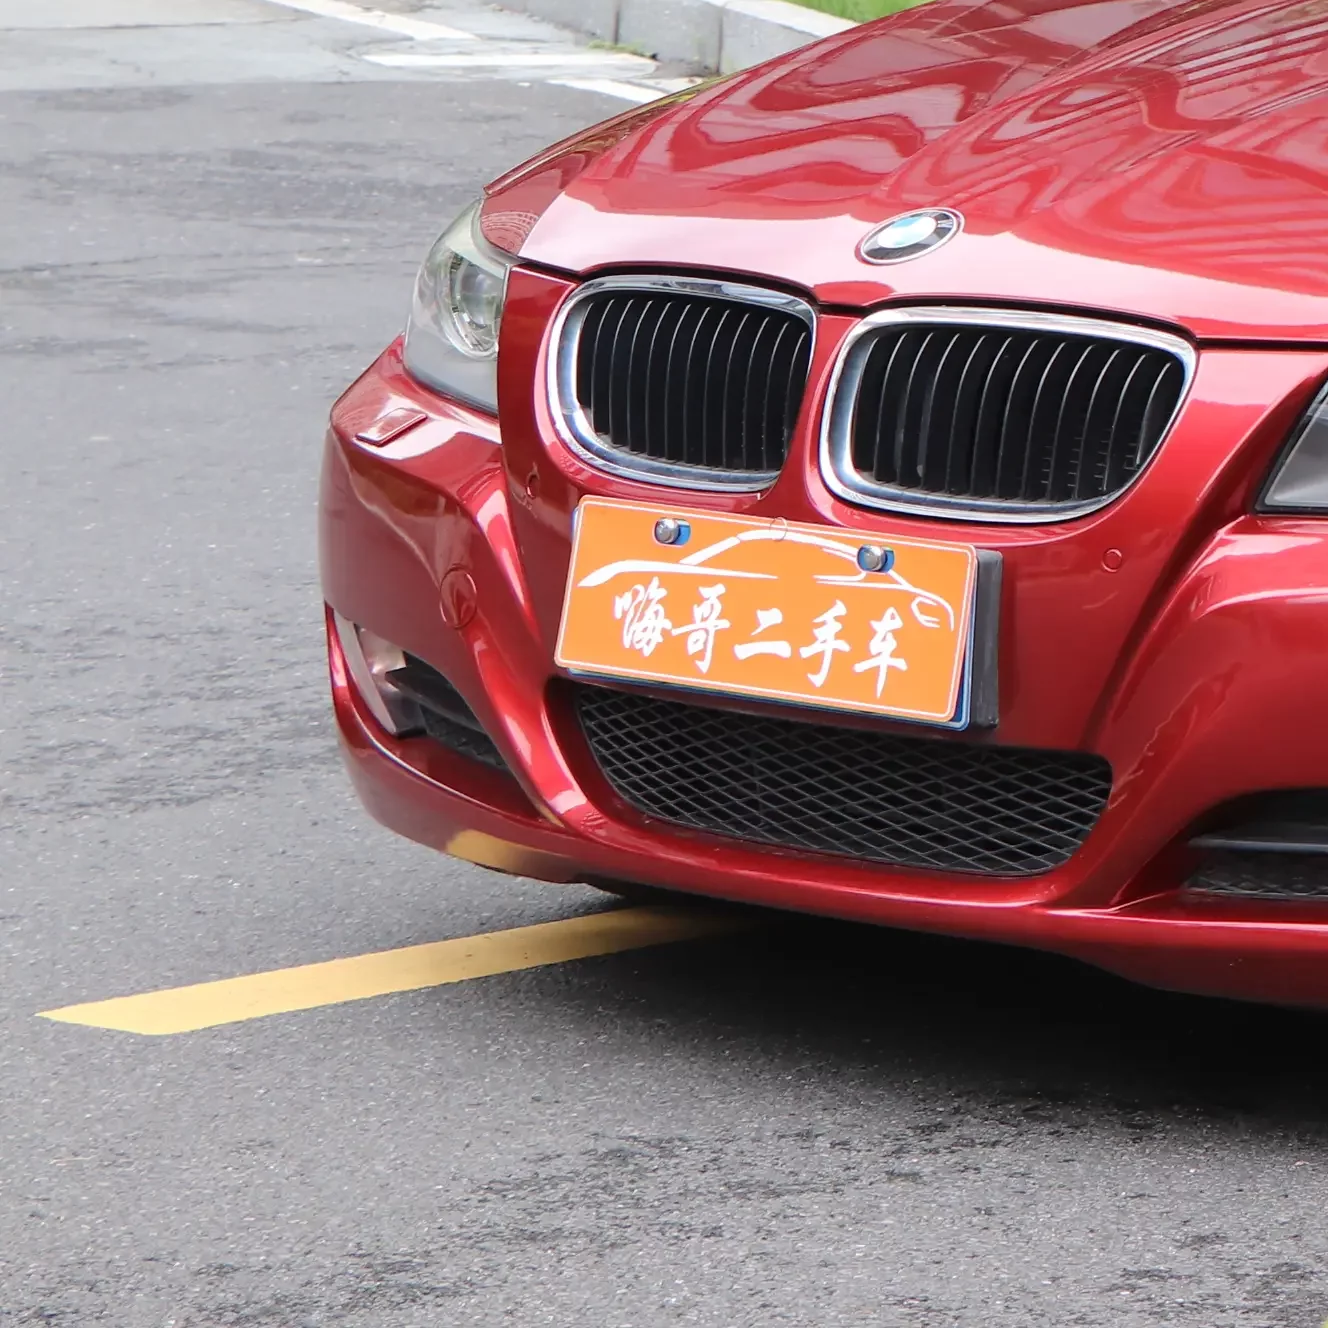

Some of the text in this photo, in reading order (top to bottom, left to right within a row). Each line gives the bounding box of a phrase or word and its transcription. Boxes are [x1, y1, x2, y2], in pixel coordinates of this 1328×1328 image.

[613, 576, 908, 698] 嗨哥二手车
